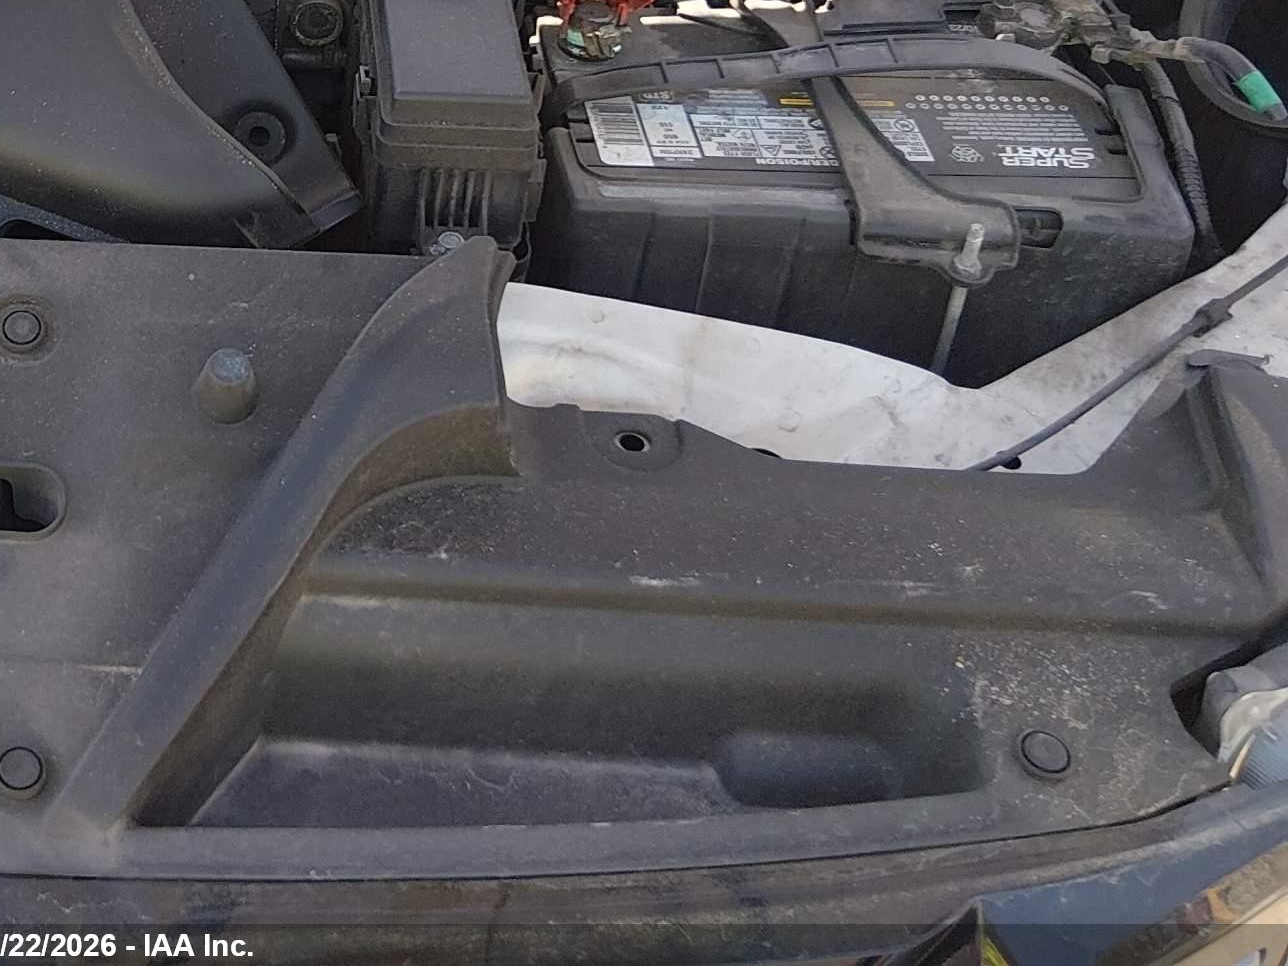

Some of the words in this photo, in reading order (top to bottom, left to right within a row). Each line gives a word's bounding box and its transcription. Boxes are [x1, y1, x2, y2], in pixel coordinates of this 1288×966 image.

[998, 147, 1094, 160] START
[755, 158, 840, 167] GER/POISON
[1002, 157, 1089, 169] SUPER
